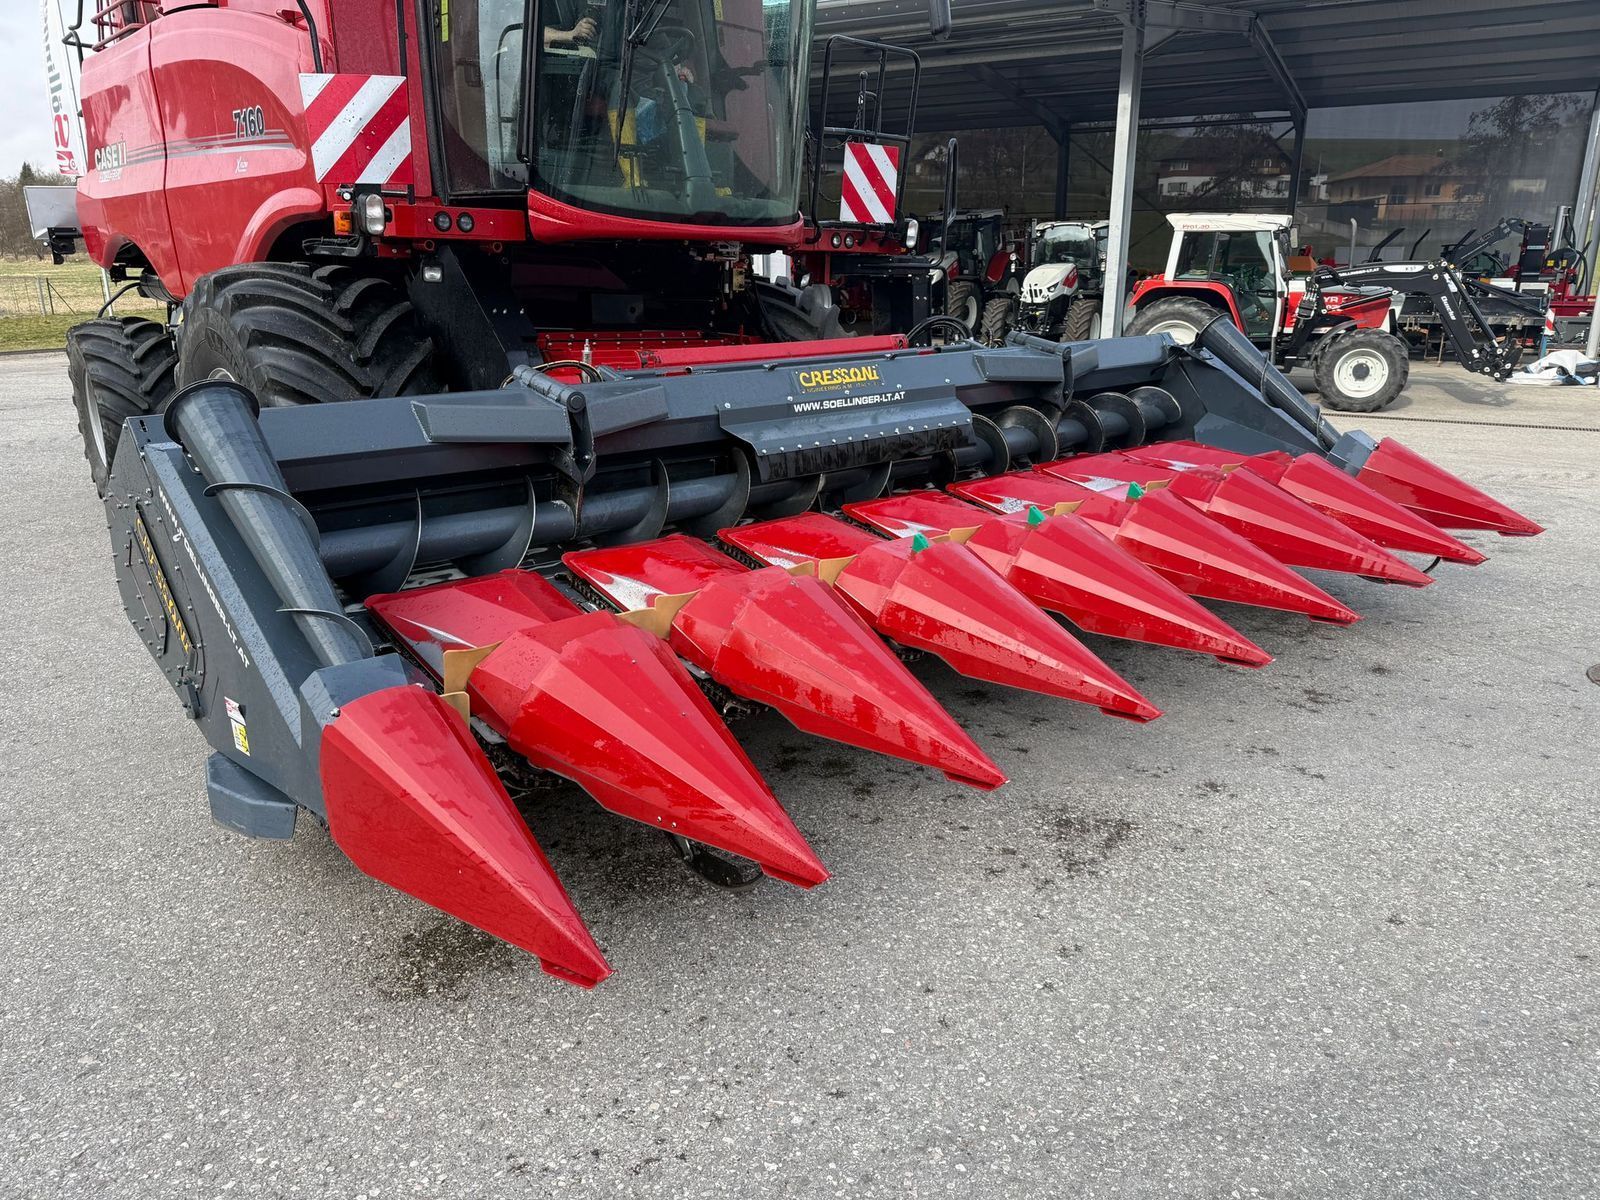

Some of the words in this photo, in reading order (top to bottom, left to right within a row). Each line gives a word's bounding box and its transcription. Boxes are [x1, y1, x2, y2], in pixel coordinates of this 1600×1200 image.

[232, 105, 265, 139] 7160
[95, 143, 119, 171] CASE
[793, 391, 906, 413] WWW.SOELLINGER-LT.AT
